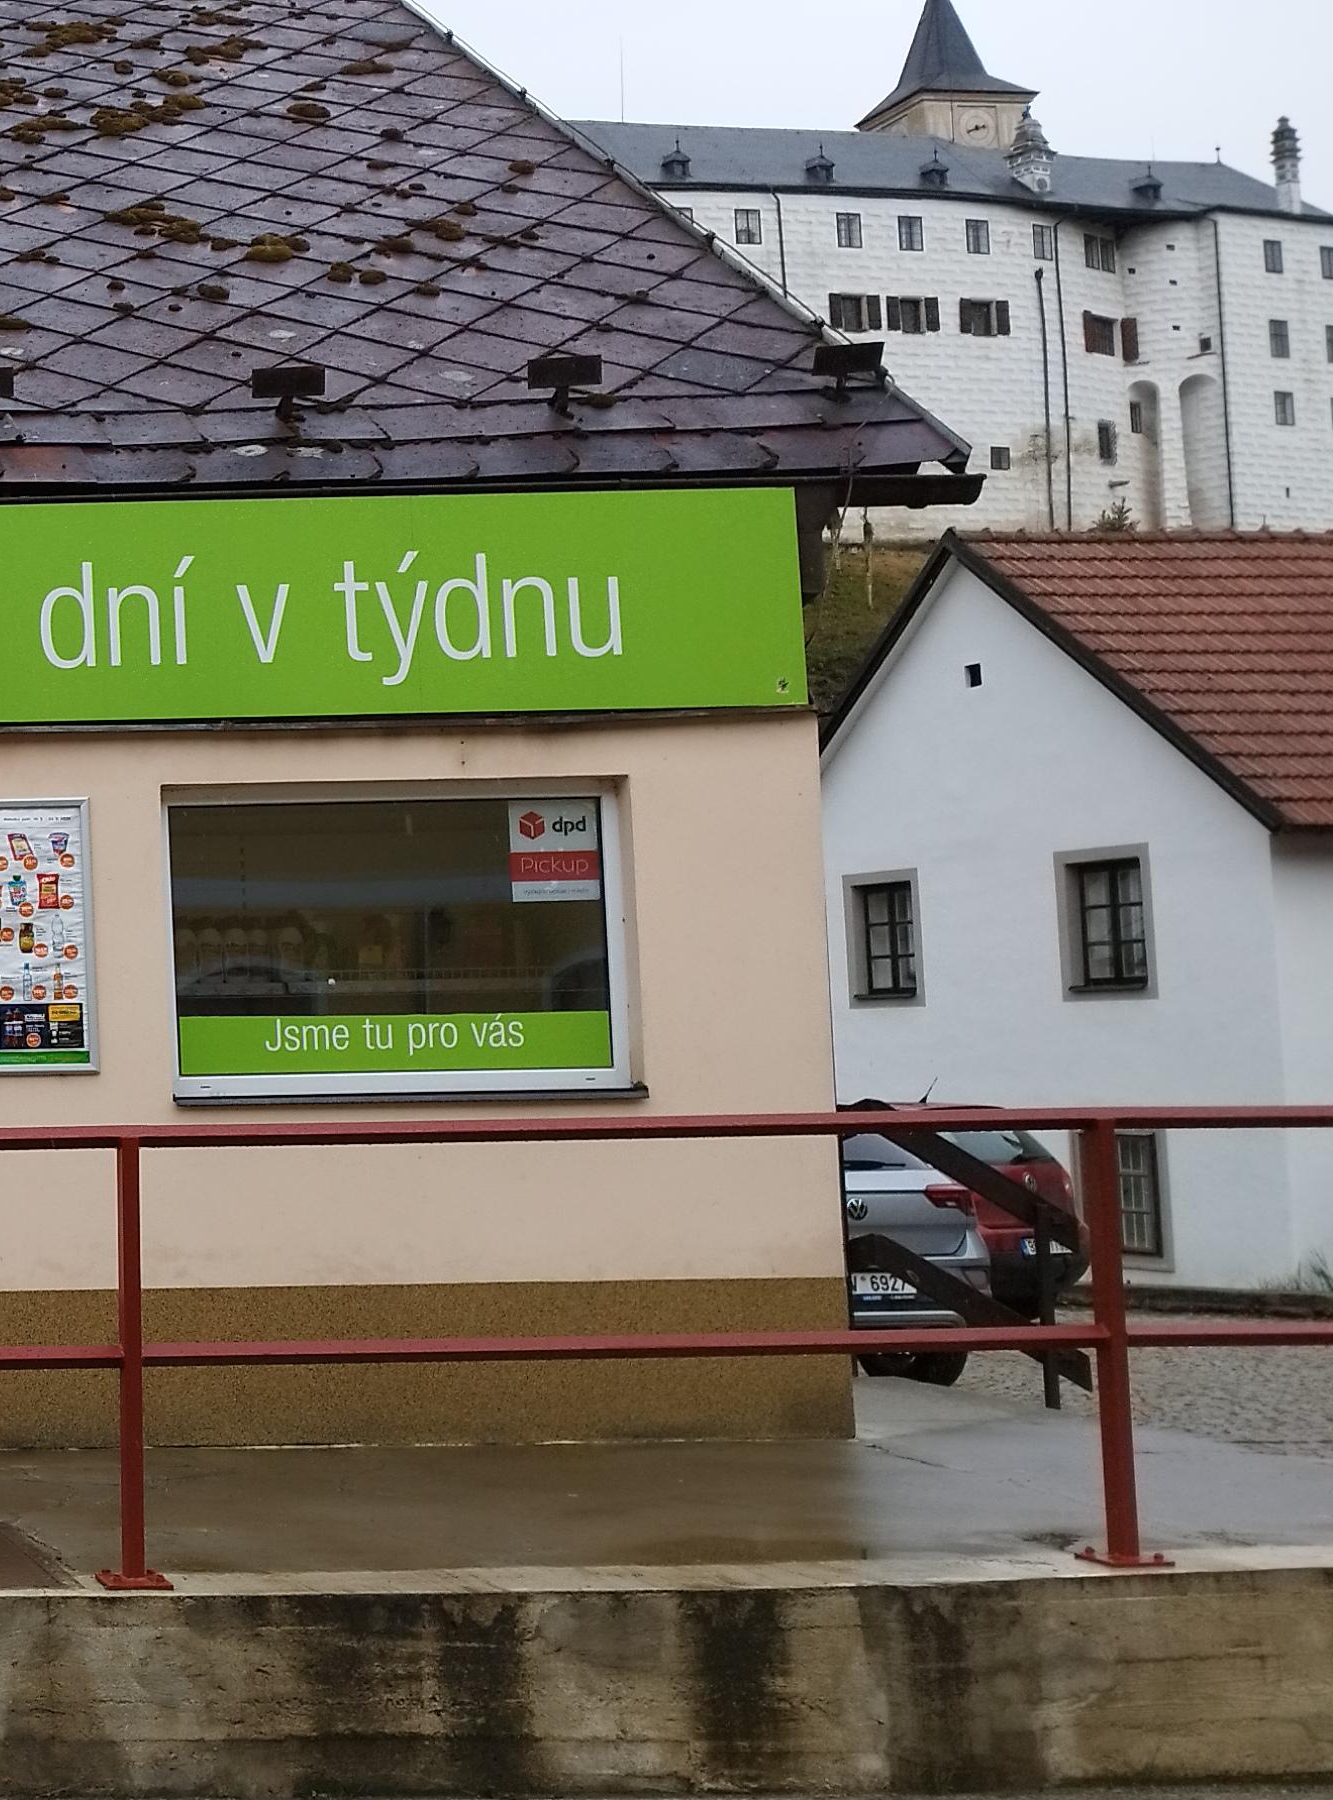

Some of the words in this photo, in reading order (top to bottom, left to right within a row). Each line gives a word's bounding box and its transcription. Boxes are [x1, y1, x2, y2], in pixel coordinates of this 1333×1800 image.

[39, 555, 195, 669] dní
[234, 583, 291, 665] v
[333, 549, 624, 686] týdnu
[551, 815, 587, 836] dpd
[520, 855, 589, 875] Pickup
[264, 1017, 350, 1052] Jsme
[362, 1017, 394, 1050] tu
[407, 1022, 459, 1057] pro
[469, 1012, 526, 1048] vás
